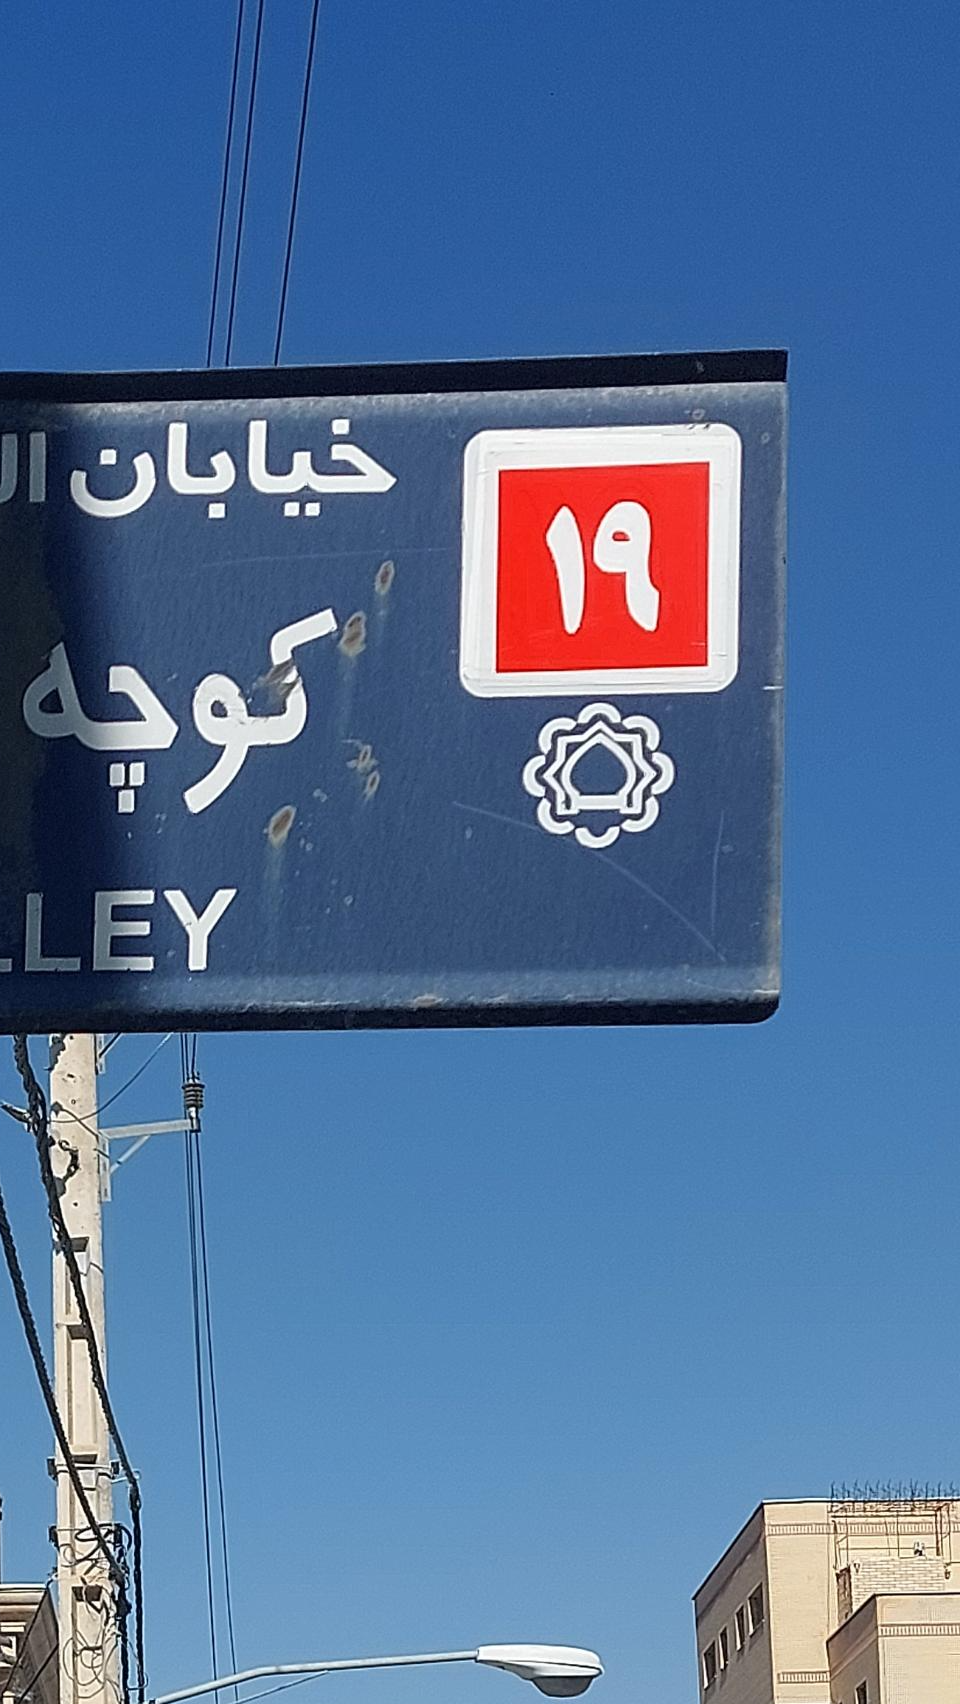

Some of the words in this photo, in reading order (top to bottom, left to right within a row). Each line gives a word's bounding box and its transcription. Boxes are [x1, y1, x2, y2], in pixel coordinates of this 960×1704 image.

[70, 417, 397, 519] خیابان
[545, 500, 660, 634] ۱۹
[22, 607, 338, 814] کوچه
